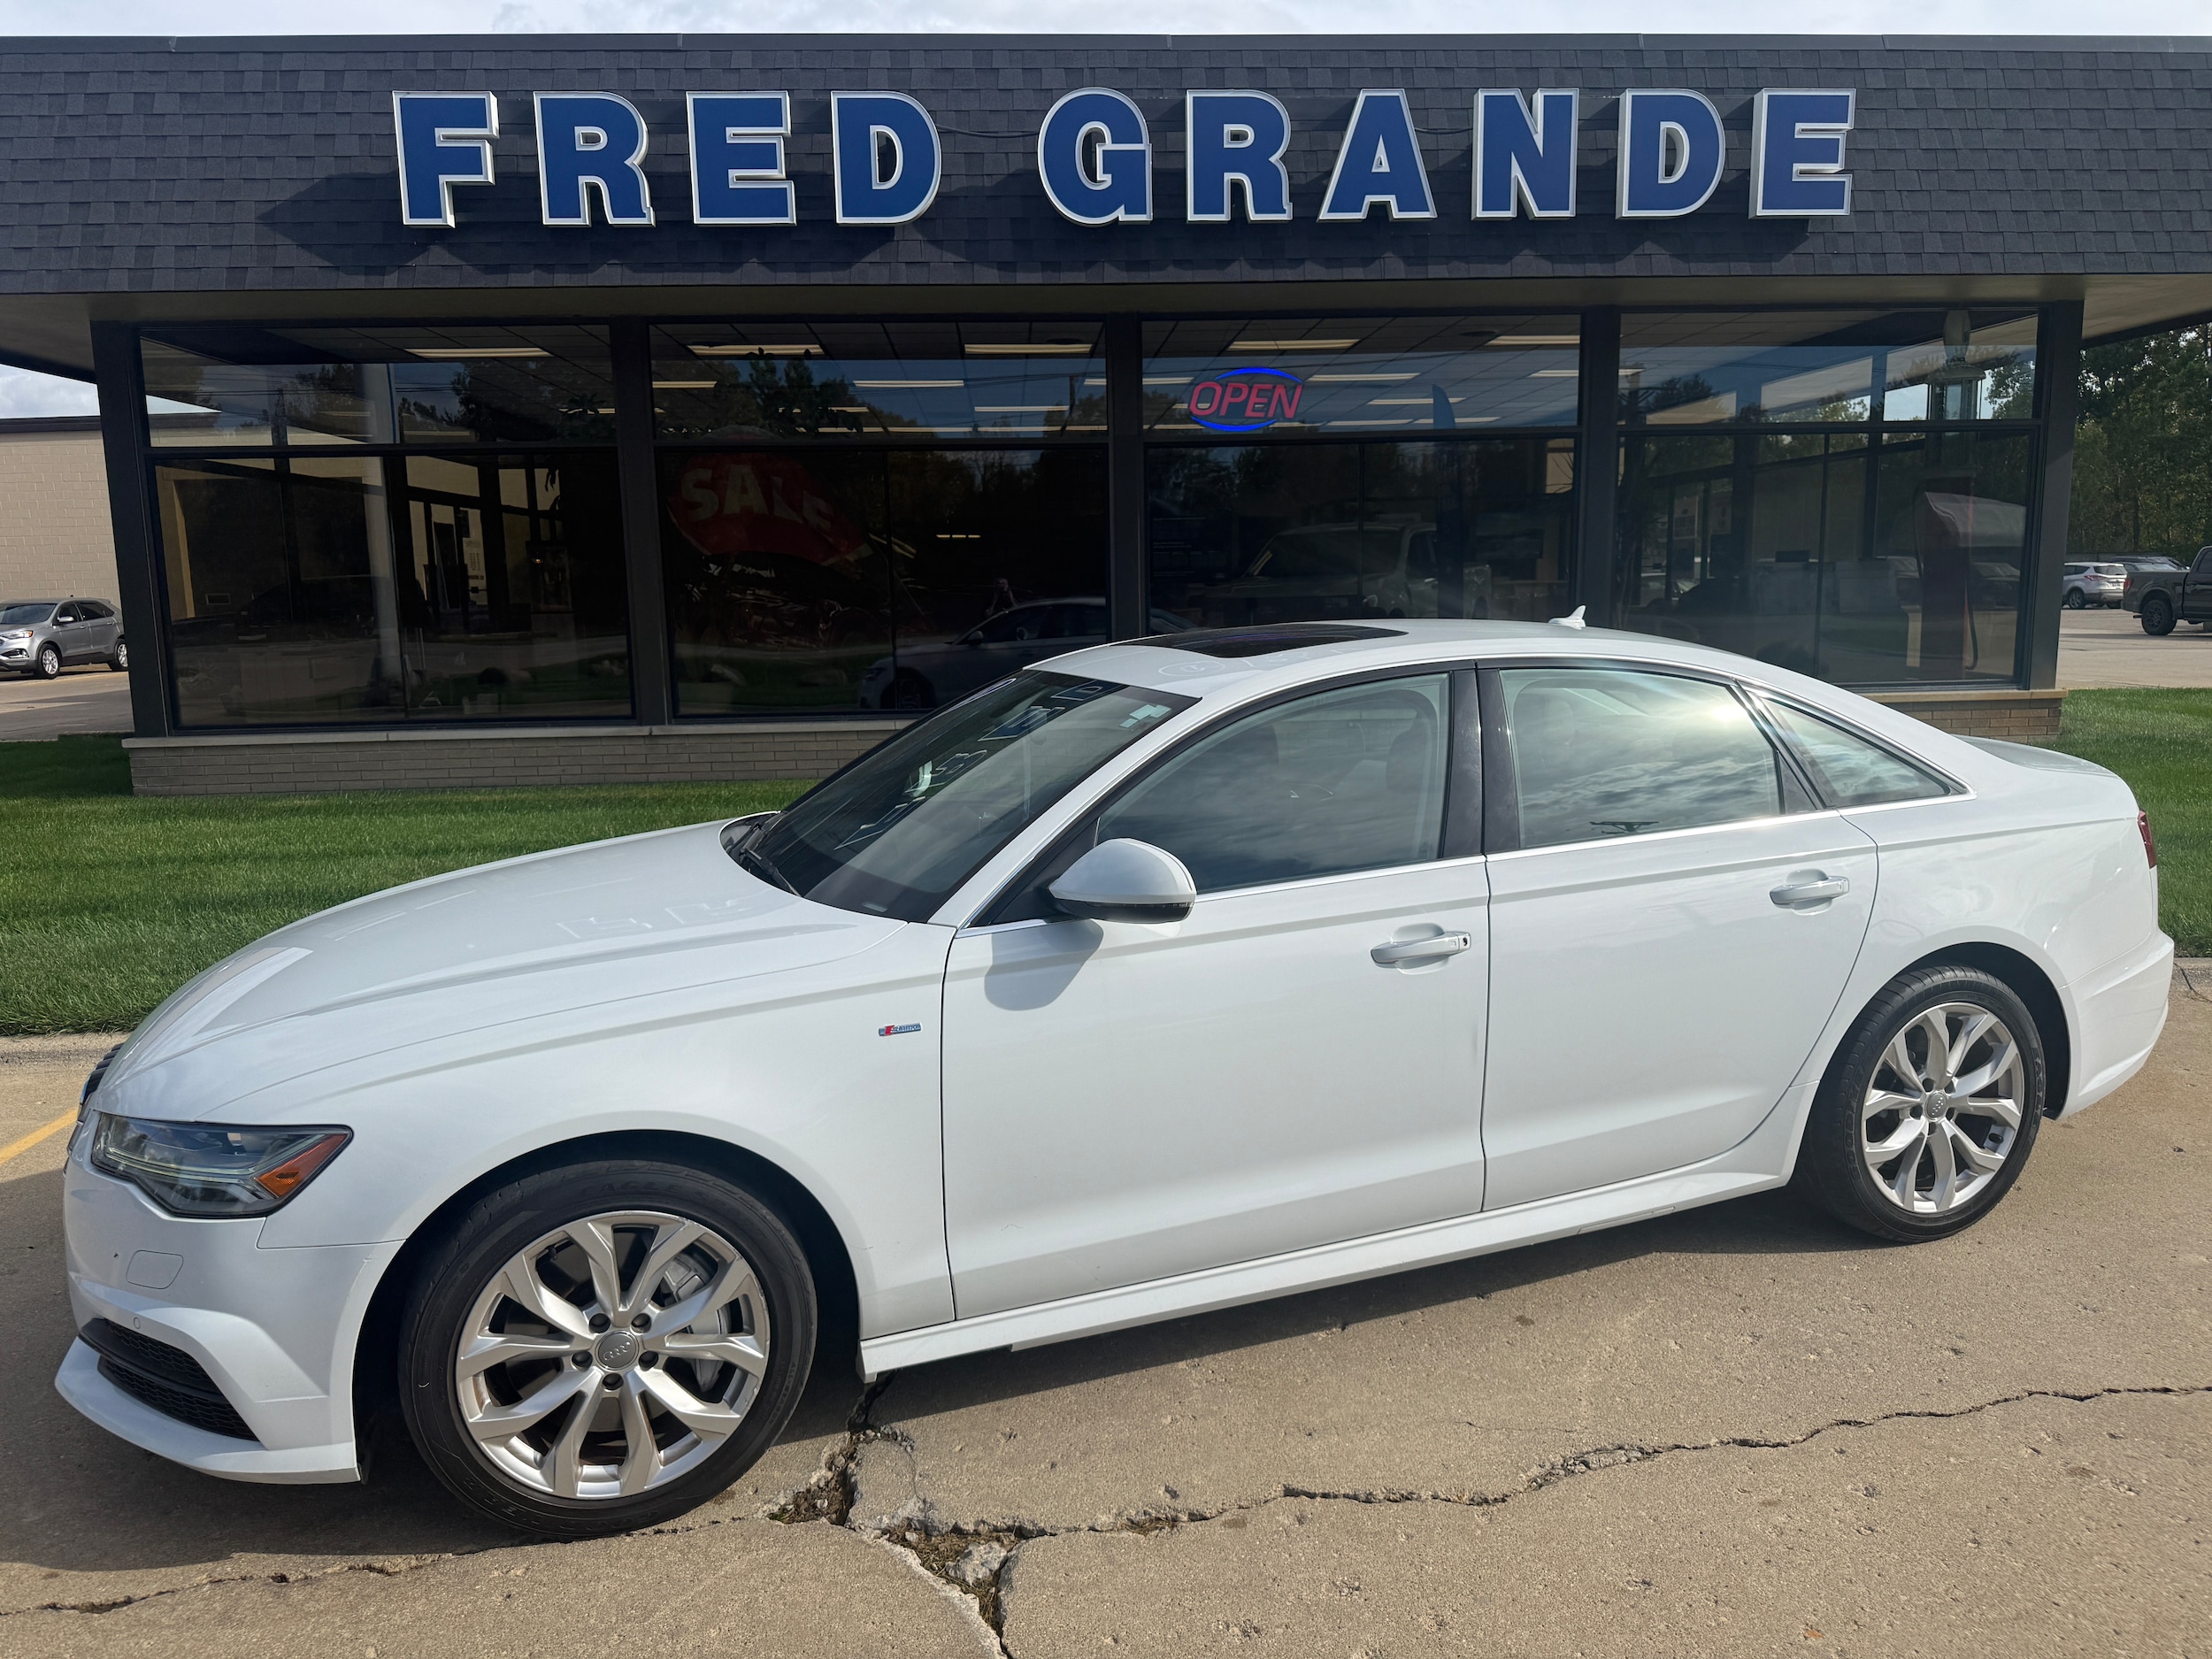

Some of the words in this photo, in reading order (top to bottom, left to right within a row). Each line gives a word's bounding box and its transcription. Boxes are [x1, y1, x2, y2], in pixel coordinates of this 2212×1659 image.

[392, 90, 941, 227] FRED
[1037, 87, 1857, 227] GRANDE
[1189, 381, 1303, 419] OPEN
[680, 464, 834, 535] SALE
